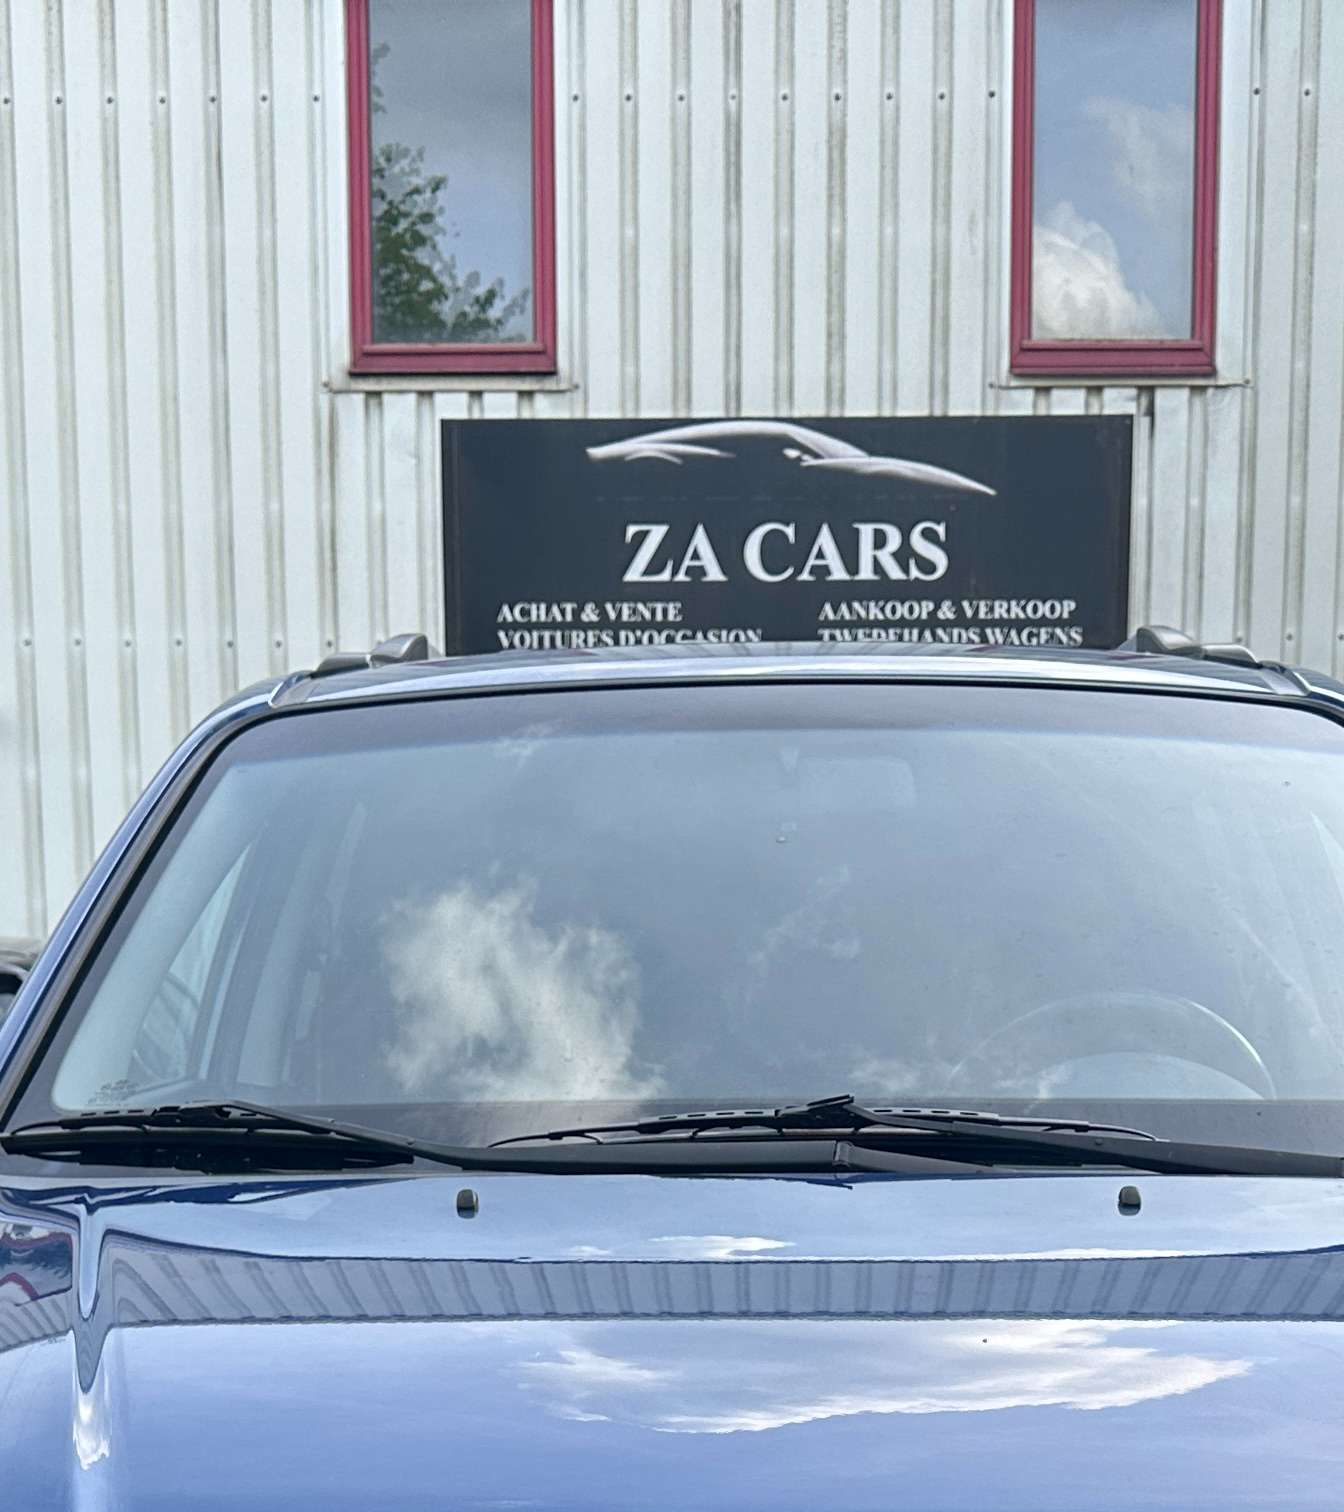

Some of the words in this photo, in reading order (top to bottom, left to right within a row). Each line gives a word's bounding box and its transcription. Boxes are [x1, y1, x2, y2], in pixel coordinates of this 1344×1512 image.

[622, 523, 728, 583] ZA
[743, 521, 949, 583] CARS
[497, 602, 577, 623] ACHAT
[580, 602, 600, 623] &
[605, 602, 683, 623] VENTE
[818, 600, 935, 621] AANKOOP
[936, 600, 957, 621] &
[961, 600, 1077, 621] VERKOOP
[497, 629, 615, 650] VOITURES
[984, 626, 1084, 647] WAGENS
